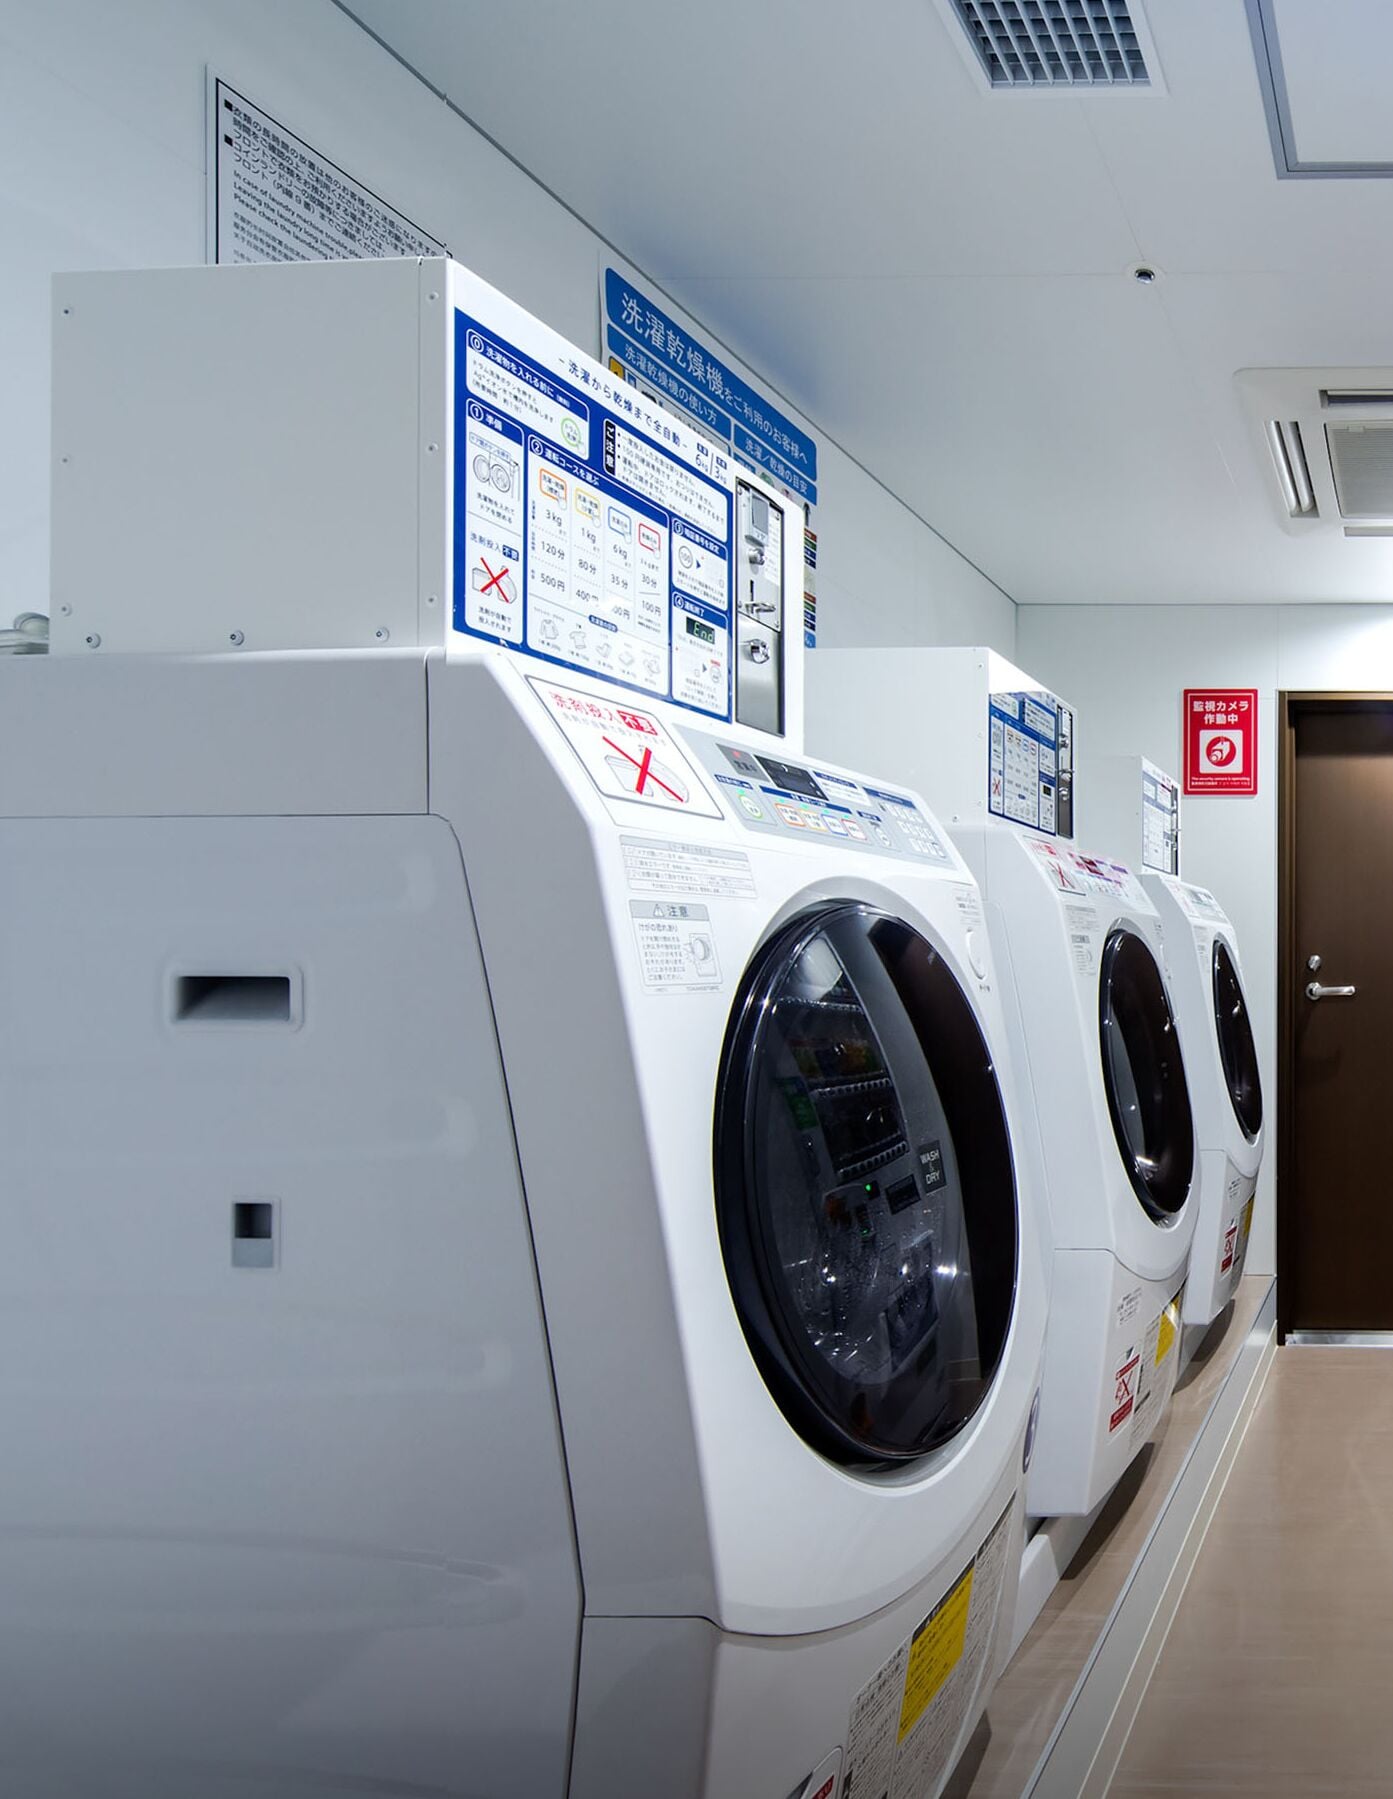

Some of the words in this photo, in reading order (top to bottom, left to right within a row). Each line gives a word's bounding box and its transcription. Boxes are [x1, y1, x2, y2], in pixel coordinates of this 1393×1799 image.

[485, 344, 554, 399] 洗濯物を入れる前に
[621, 292, 808, 464] 洗濯乾燥機をご利用のお客様へ
[625, 343, 717, 425] 洗濯乾燥機の使い方
[485, 412, 502, 432] 準備
[605, 422, 614, 469] ご注意
[544, 445, 599, 488] 運転コースを選ぶ
[470, 530, 501, 553] 洗剤投入
[541, 540, 565, 561] 120分
[578, 557, 596, 575] 80分
[540, 572, 565, 593] 500円
[693, 620, 714, 643] End
[1193, 701, 1249, 712] 監視カメラ
[1204, 713, 1238, 725] 作動中
[667, 905, 689, 917] 注意
[920, 1149, 940, 1164] WASH
[926, 1170, 940, 1184] DRY
